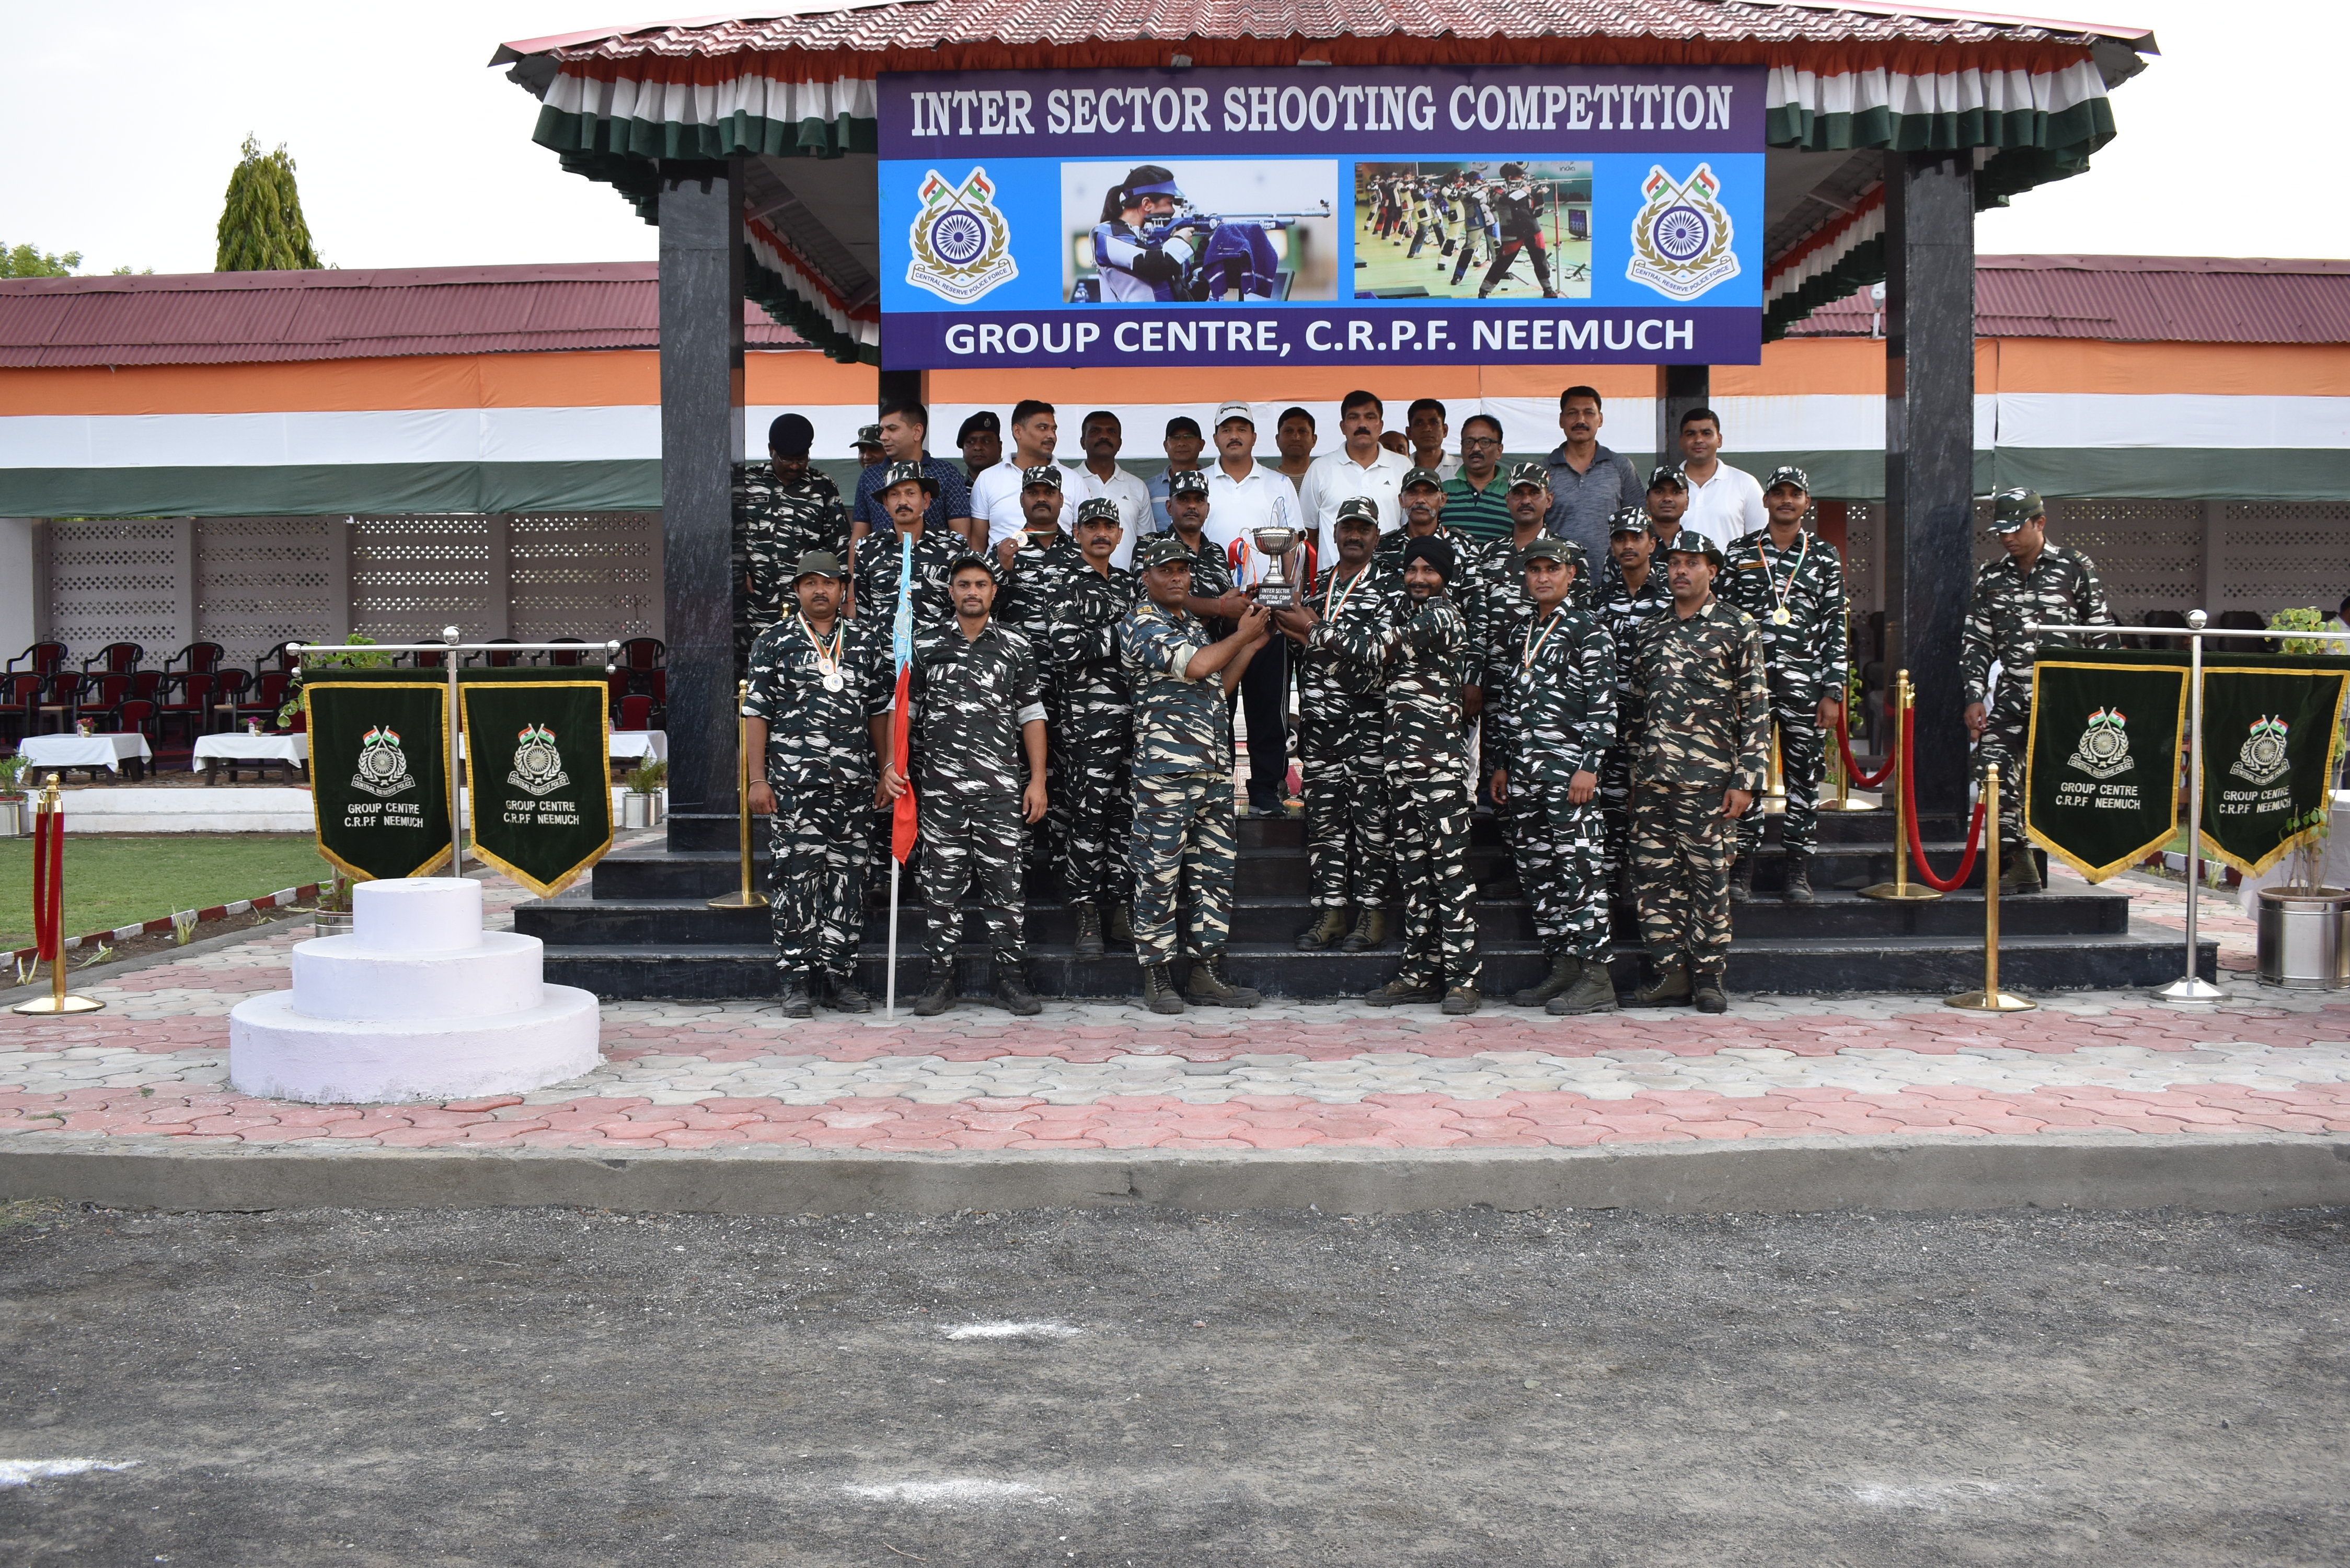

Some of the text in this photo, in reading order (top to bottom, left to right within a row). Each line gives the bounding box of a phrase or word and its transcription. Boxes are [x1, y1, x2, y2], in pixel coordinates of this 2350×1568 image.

[911, 85, 1733, 136] INTER SECTOR SHOOTING COMPETITION
[915, 268, 1007, 295] CENTRAL RESERVE POLICE FORCE
[1635, 265, 1729, 292] CENTRAL RESERVE POLICE FORCE
[945, 319, 1694, 357] GROUP CENTRE, C.R.P.F. NEEMUCH
[2071, 759, 2132, 777] CENTRAL RESERVE POLICE
[2233, 768, 2255, 780] CENTRAL
[354, 780, 412, 795] CENTRAL RESERVE POLICE
[510, 778, 567, 794] CENTRAL RESERVE POLICE
[2060, 782, 2138, 796] GROUP CENTRE
[2223, 785, 2290, 801] GROUP CENTRE
[348, 802, 420, 814] GROUP CENTRE
[505, 800, 575, 812] GROUP CENTRE
[2055, 795, 2140, 810] C.R.P.F NEEMUCH
[2219, 797, 2291, 814] C.R.P.F NEEMUCH
[344, 815, 423, 828] C.R.P.F NEEMUCH
[503, 812, 579, 825] C.R.P.F NEEMUCH
